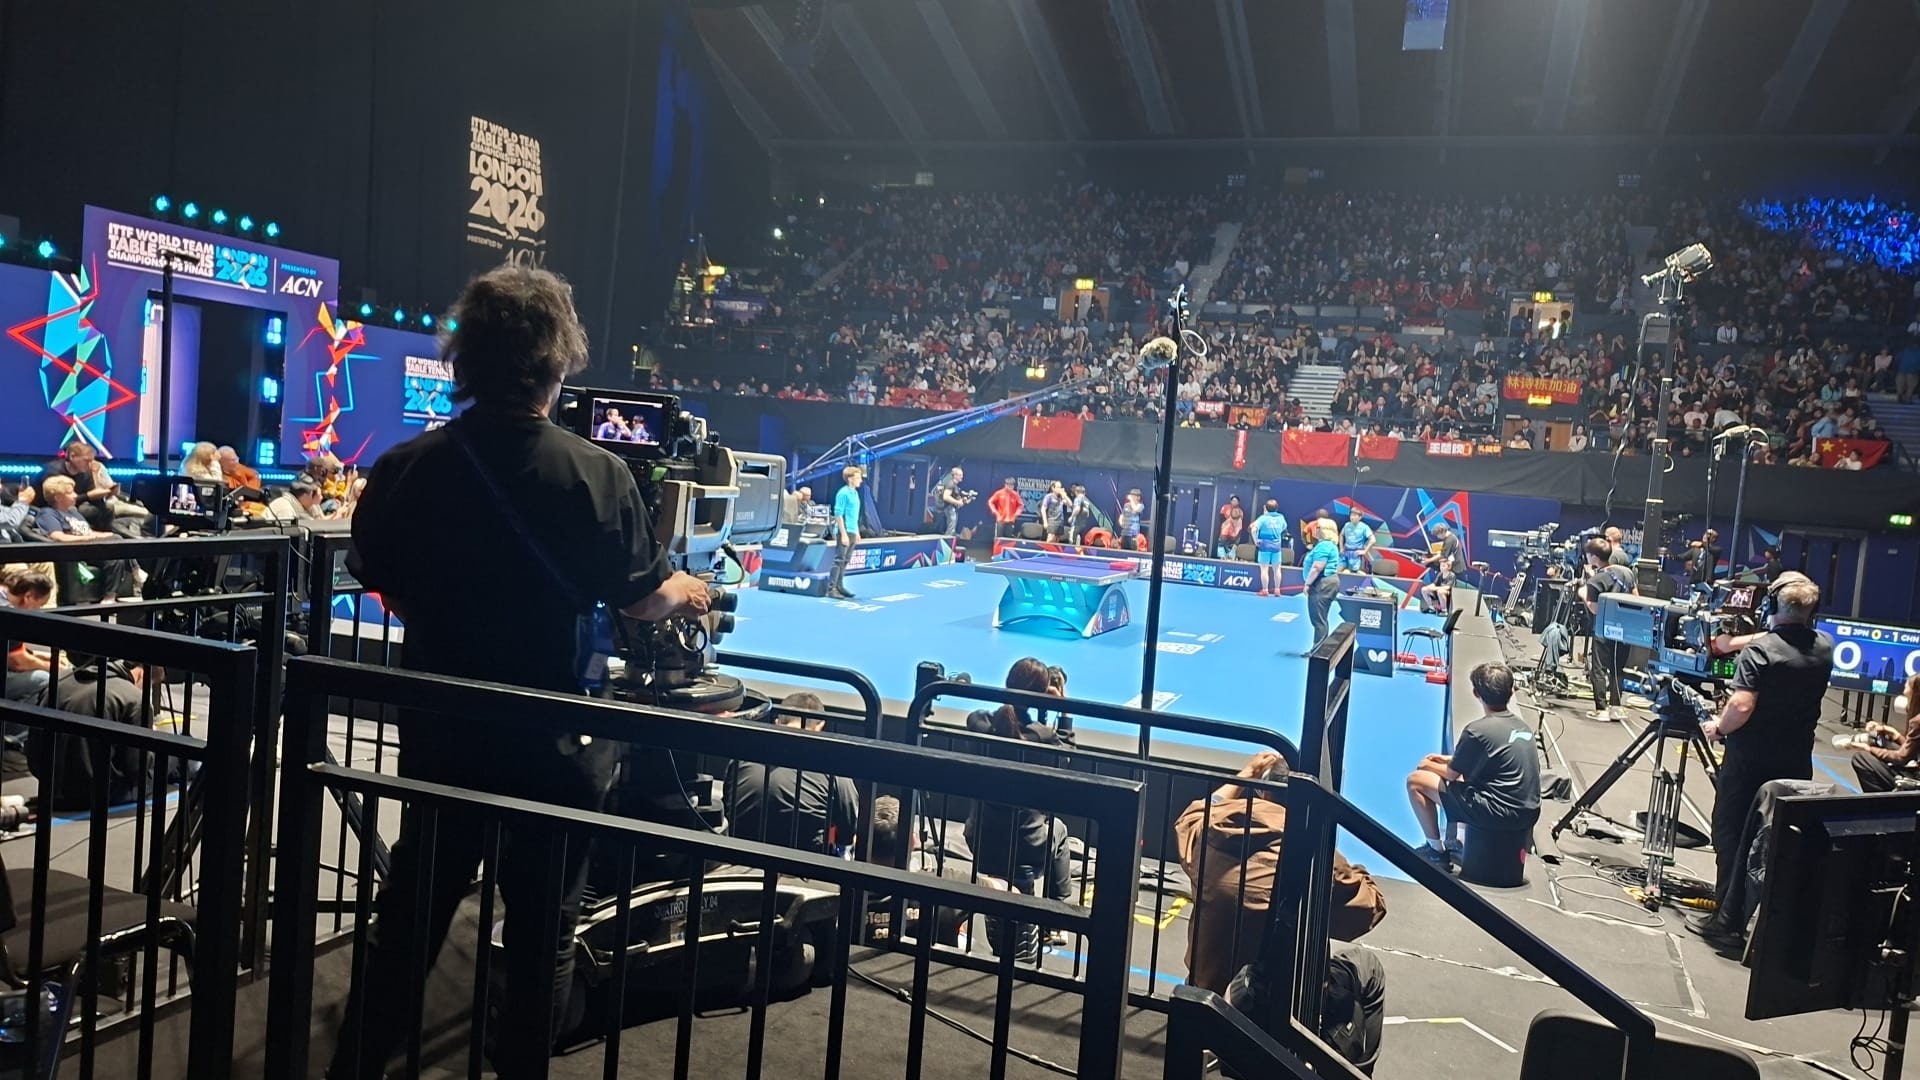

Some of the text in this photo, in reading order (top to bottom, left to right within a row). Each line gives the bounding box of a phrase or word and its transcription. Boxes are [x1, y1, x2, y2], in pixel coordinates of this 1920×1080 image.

[471, 116, 540, 153] ITTF WORLD TEAM
[471, 128, 541, 166] TABLE TENNIS
[469, 150, 544, 196] LONDON
[469, 176, 546, 233] 2026
[108, 222, 214, 255] ITTF WORLD TEAM
[108, 235, 157, 258] TABLE
[107, 249, 214, 277] CHAMPIONSPS FINALS
[215, 245, 268, 268] LONDON
[215, 260, 268, 287] 2026
[280, 275, 323, 298] ACN
[1224, 575, 1253, 587] ACN
[1853, 628, 1869, 637] JPN
[1872, 629, 1881, 640] 0
[1892, 631, 1899, 643] 1
[1900, 634, 1920, 644] CHN
[1833, 641, 1861, 670] 0
